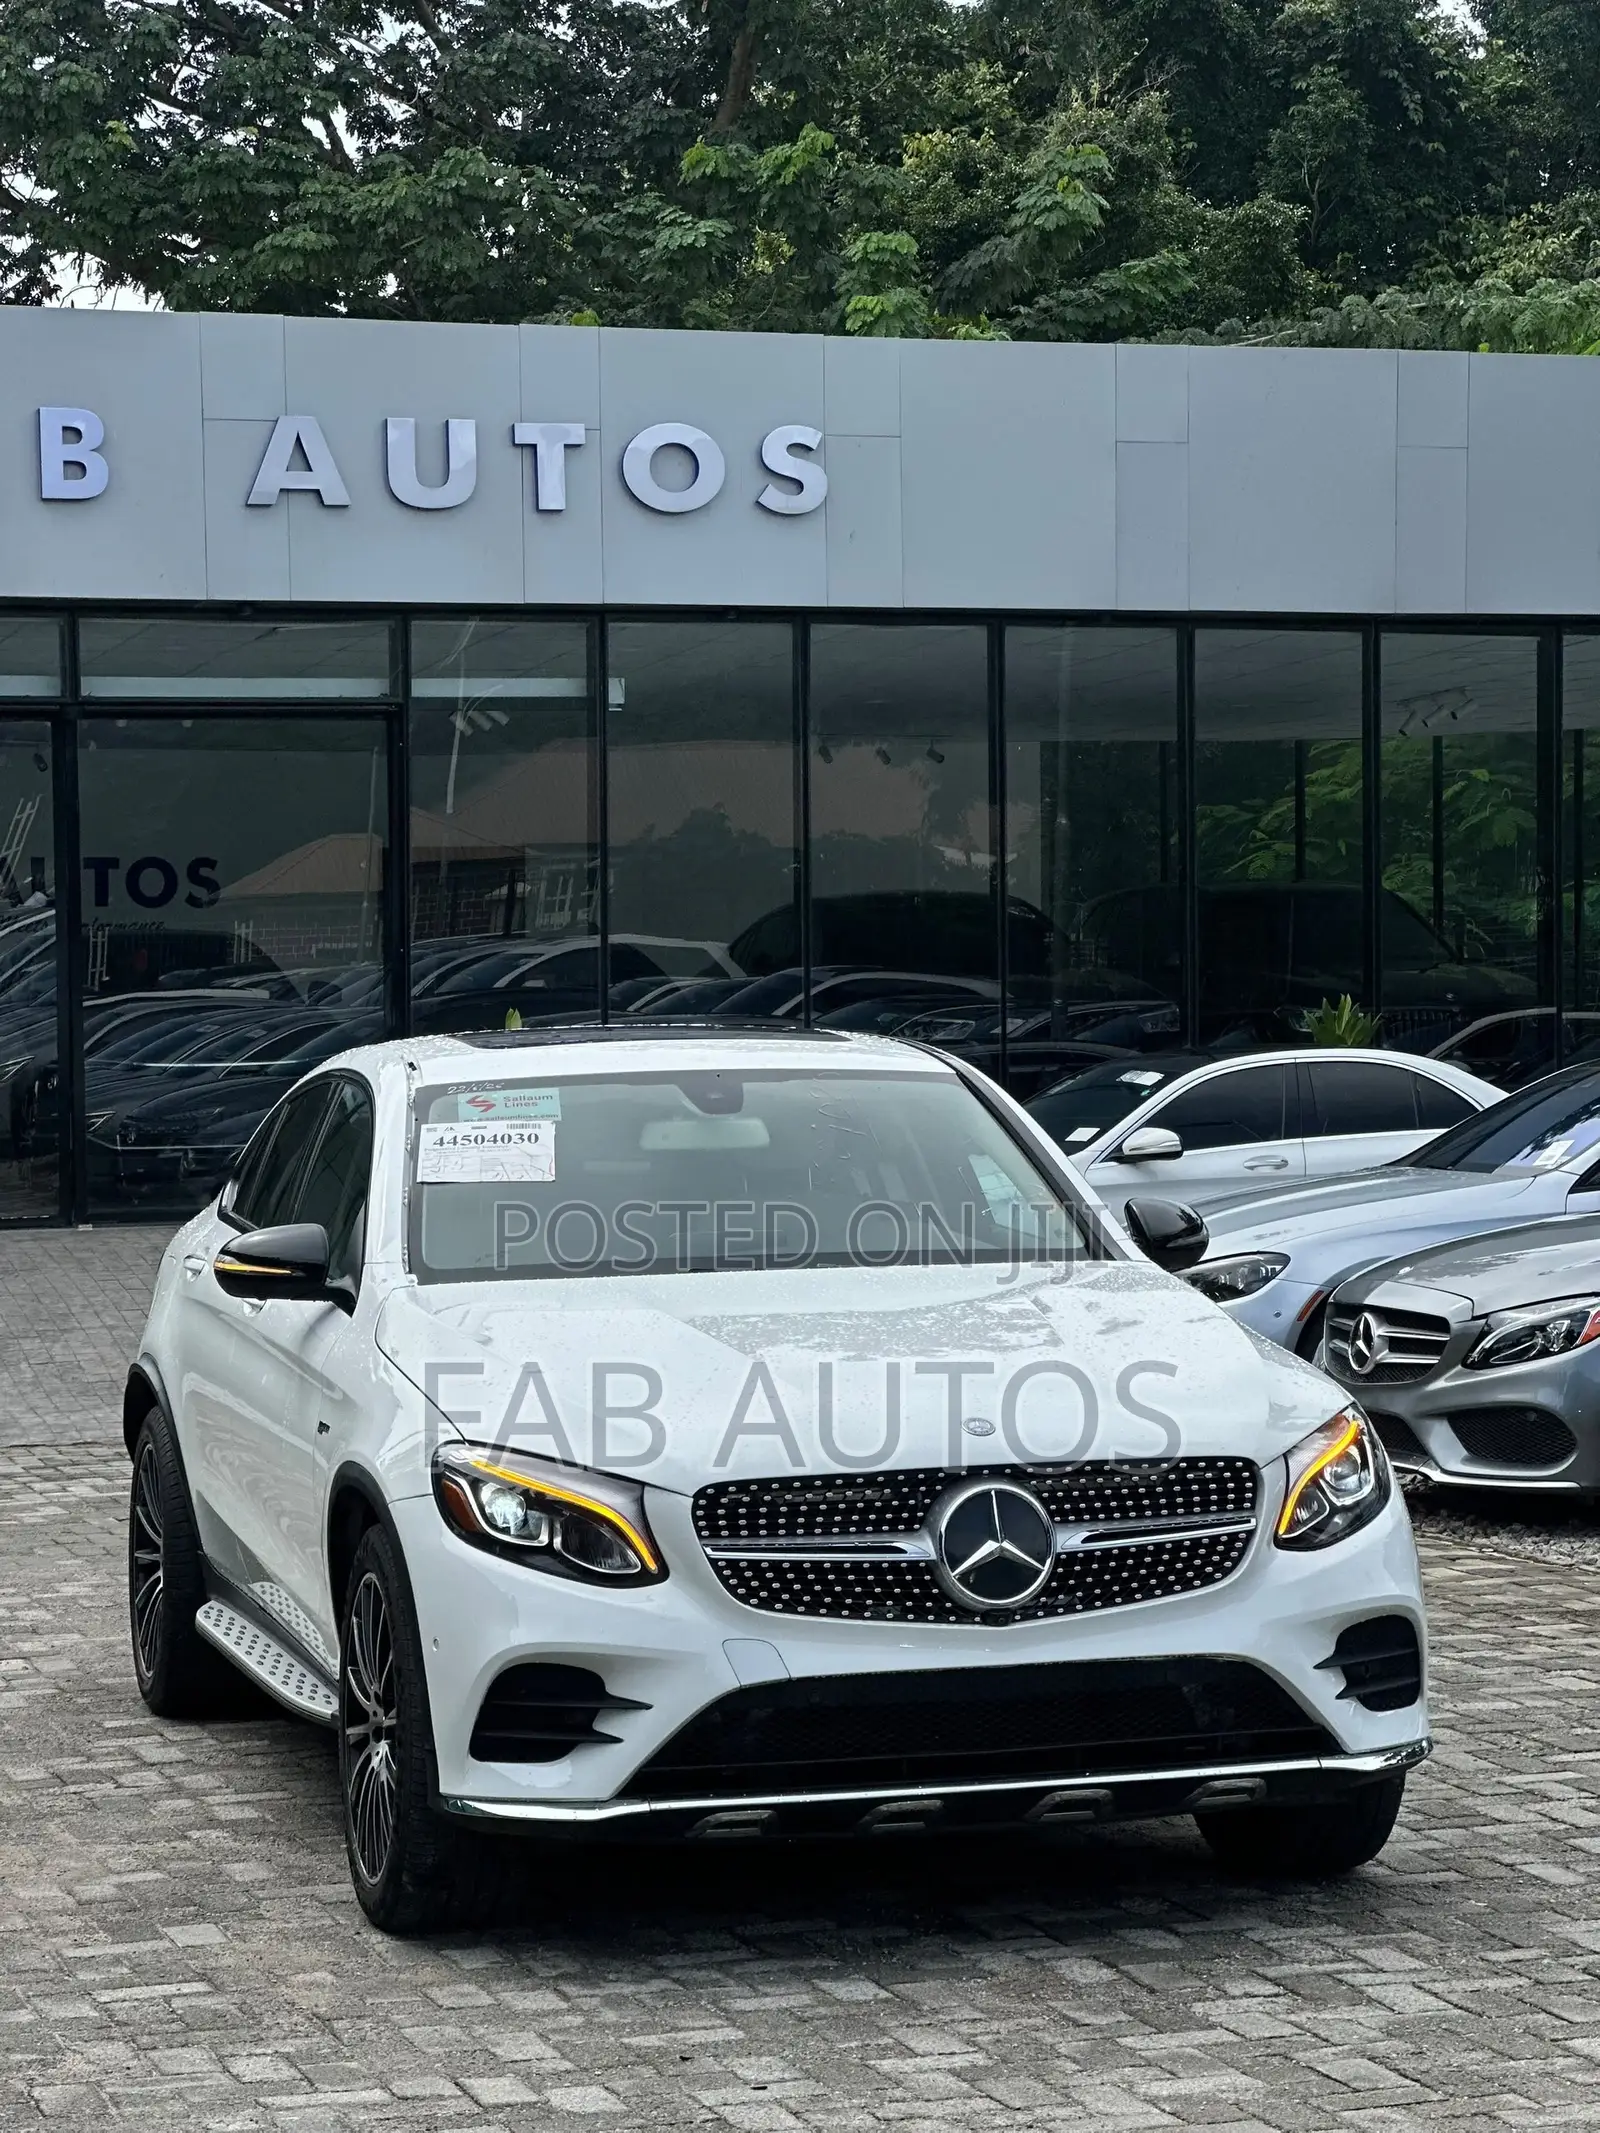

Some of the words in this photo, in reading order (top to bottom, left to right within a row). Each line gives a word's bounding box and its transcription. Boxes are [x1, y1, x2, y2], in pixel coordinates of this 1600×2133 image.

[37, 407, 110, 502] B
[247, 414, 829, 515] AUTOS
[503, 1093, 553, 1103] Sallaum
[433, 1133, 540, 1147] 44504030
